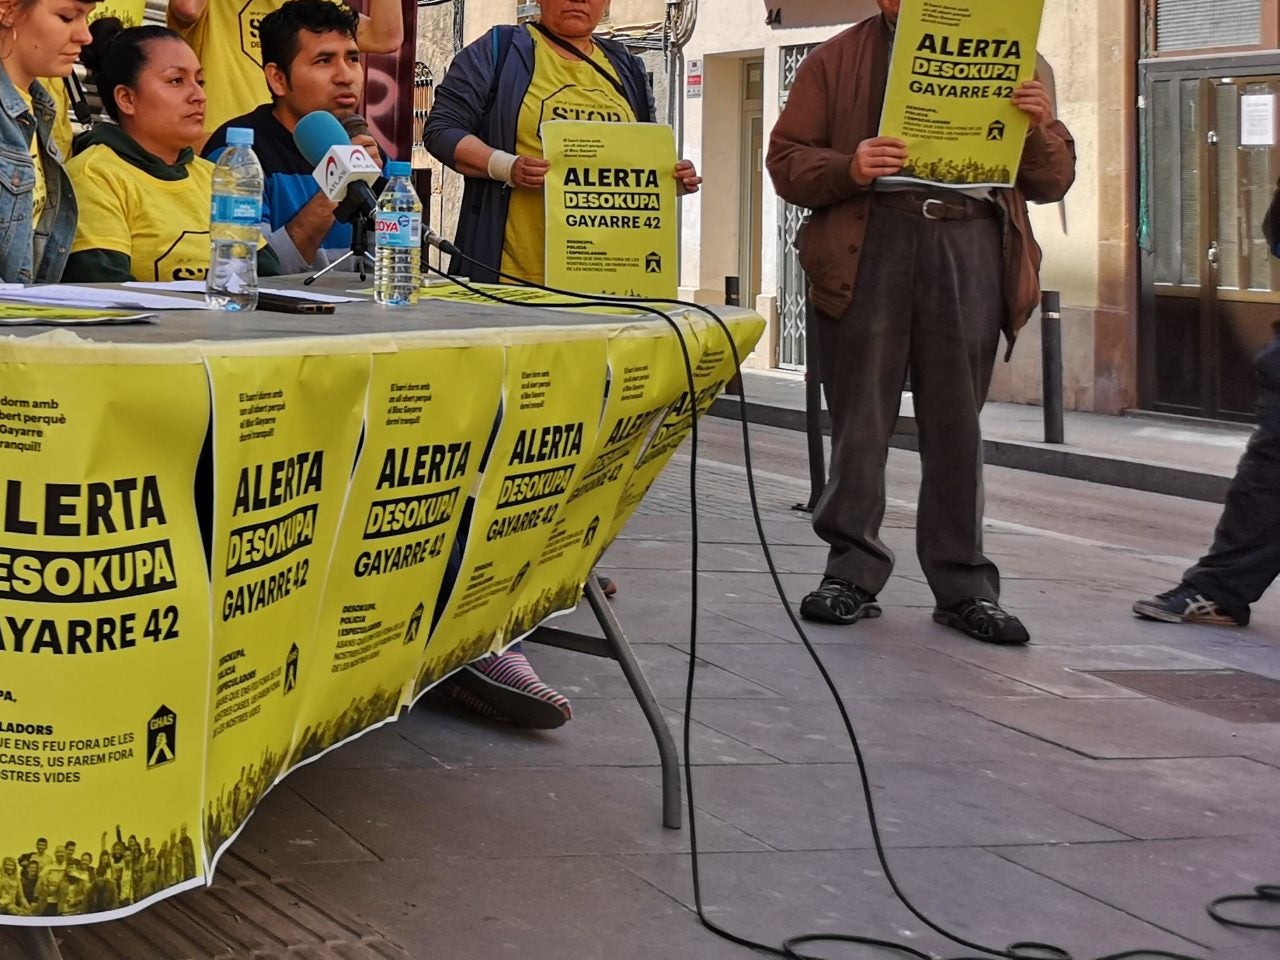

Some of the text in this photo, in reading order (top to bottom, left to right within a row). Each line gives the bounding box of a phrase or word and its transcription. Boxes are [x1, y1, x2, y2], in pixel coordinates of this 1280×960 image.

[916, 33, 1020, 59] ALERTA
[913, 58, 1017, 80] DESOKUPA
[909, 81, 1013, 98] GAYARRE 42
[328, 170, 346, 194] ATLAS
[564, 168, 659, 188] ALERTA
[565, 192, 659, 209] DESOKUPA
[566, 215, 660, 229] GAYARRE 42
[0, 396, 30, 407] dorm
[32, 399, 59, 409] amb
[0, 424, 43, 437] Gayarre
[24, 414, 66, 425] perquè
[509, 423, 583, 465] ALERTA
[376, 441, 471, 490] ALERTA
[232, 450, 324, 517] ALERTA
[500, 469, 572, 506] DESOKUPA
[365, 490, 458, 534] DESOKUPA
[487, 515, 541, 542] GAYARRE
[543, 503, 558, 524] 42
[227, 508, 314, 575] DESOKUPA
[354, 533, 446, 577] GAYARRE 42
[223, 558, 309, 622] GAYARRE 42
[143, 606, 179, 642] 42
[14, 739, 39, 751] ENS
[43, 741, 65, 751] FEU
[69, 738, 100, 750] FORA
[102, 736, 116, 748] DE
[117, 732, 134, 745] LES
[0, 753, 44, 769] CASES,
[48, 756, 64, 767] US
[68, 754, 106, 767] FAREM
[108, 749, 134, 763] FORA
[44, 772, 80, 783] VIDES
